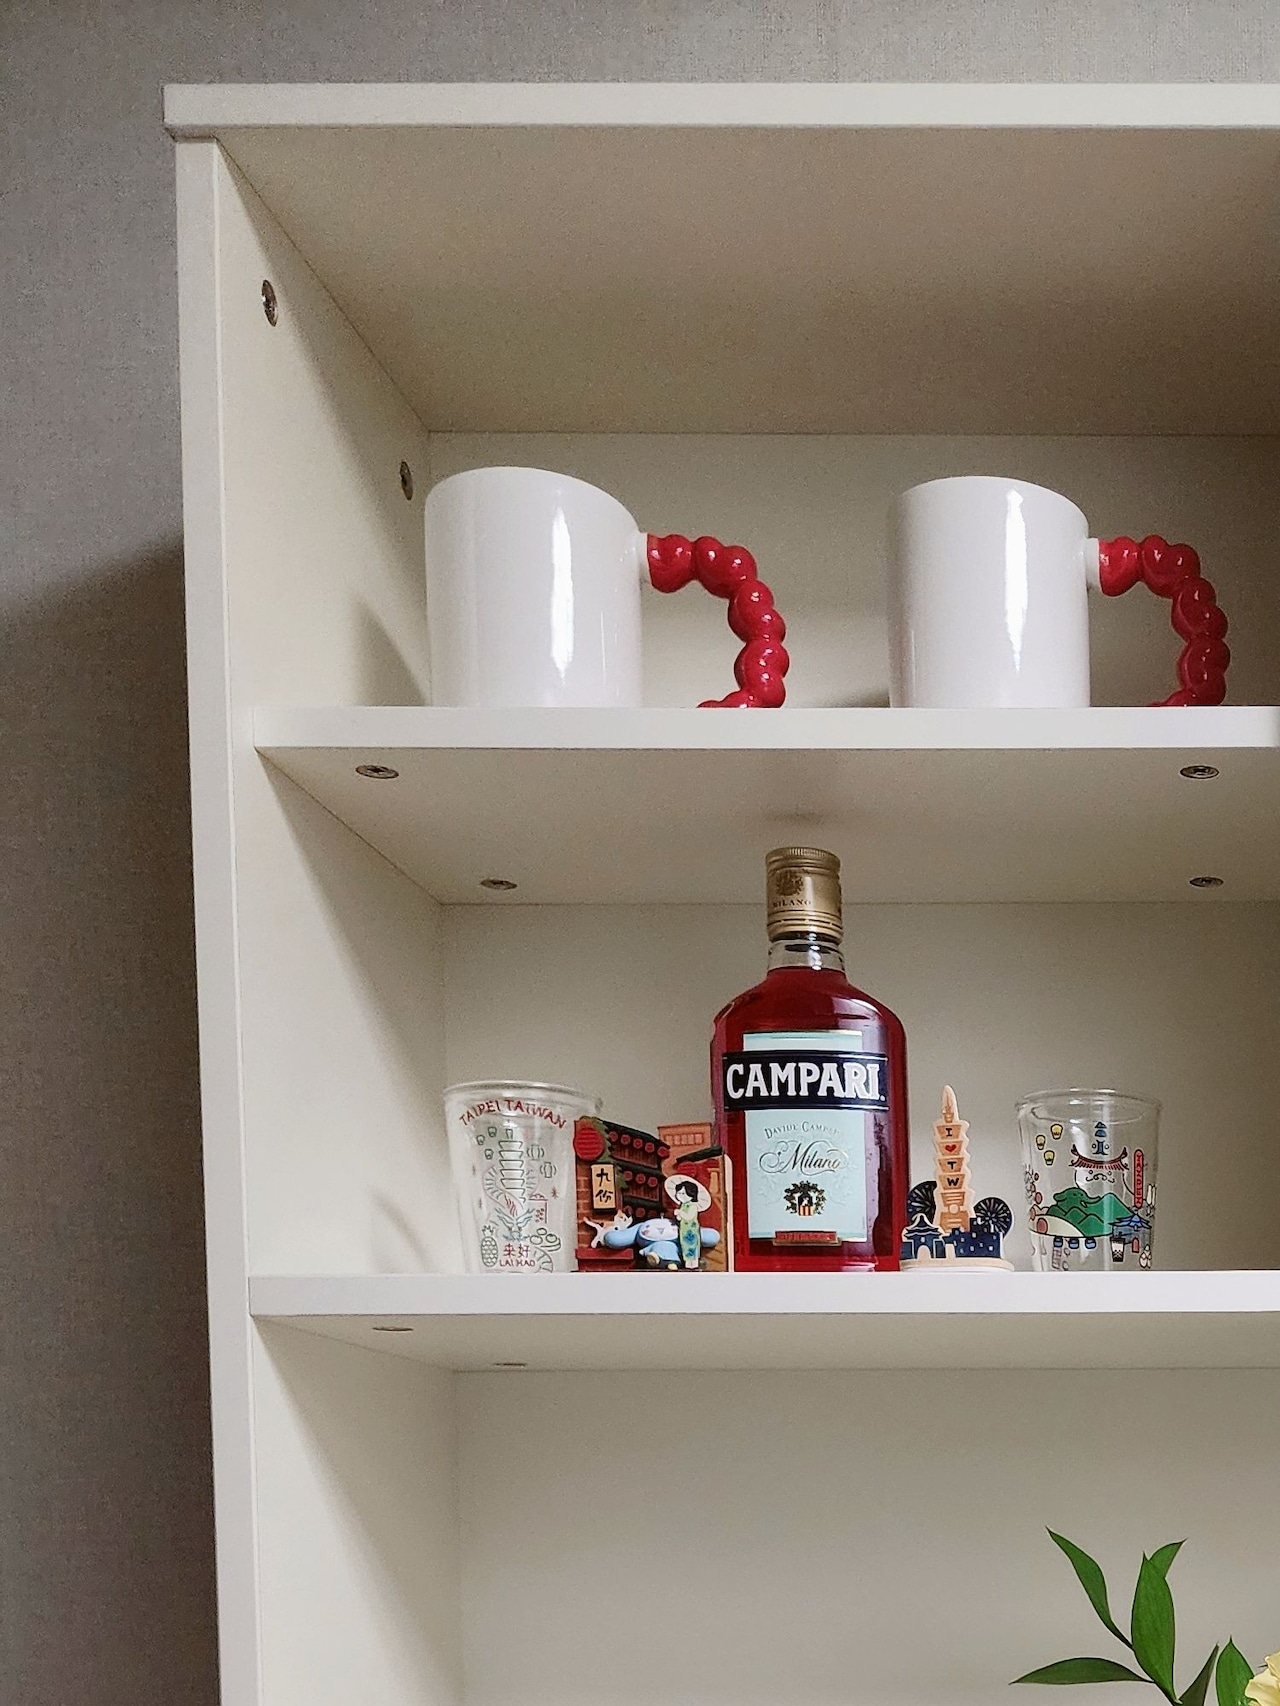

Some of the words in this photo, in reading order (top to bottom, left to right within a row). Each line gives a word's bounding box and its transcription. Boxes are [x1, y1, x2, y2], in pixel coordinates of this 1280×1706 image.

[459, 1100, 501, 1126] TAIPEI
[504, 1099, 567, 1129] TAIWAN
[759, 1140, 849, 1176] Milano
[596, 1168, 613, 1203] 九份
